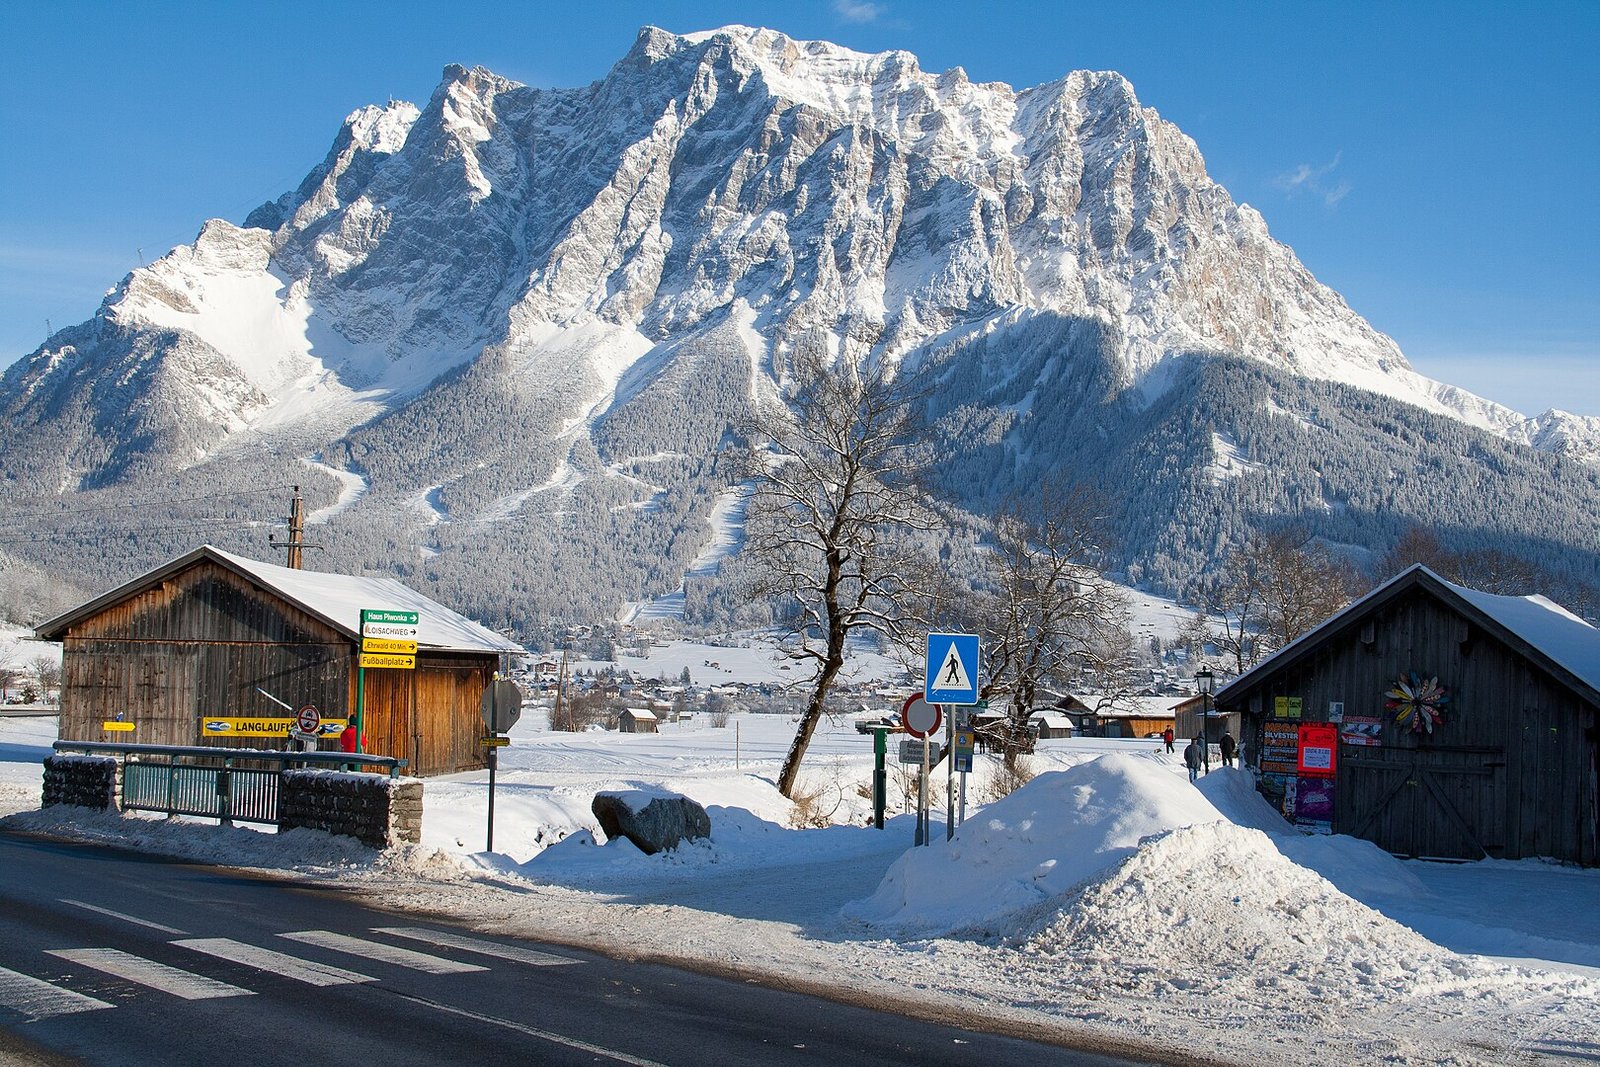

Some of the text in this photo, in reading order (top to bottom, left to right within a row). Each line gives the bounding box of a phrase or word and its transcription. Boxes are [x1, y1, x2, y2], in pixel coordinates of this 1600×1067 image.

[367, 612, 408, 621] Haus Piwonka
[368, 627, 408, 635] LOISACHWEG
[362, 656, 404, 666] Fußballplatz
[1264, 731, 1298, 740] SILVESTER
